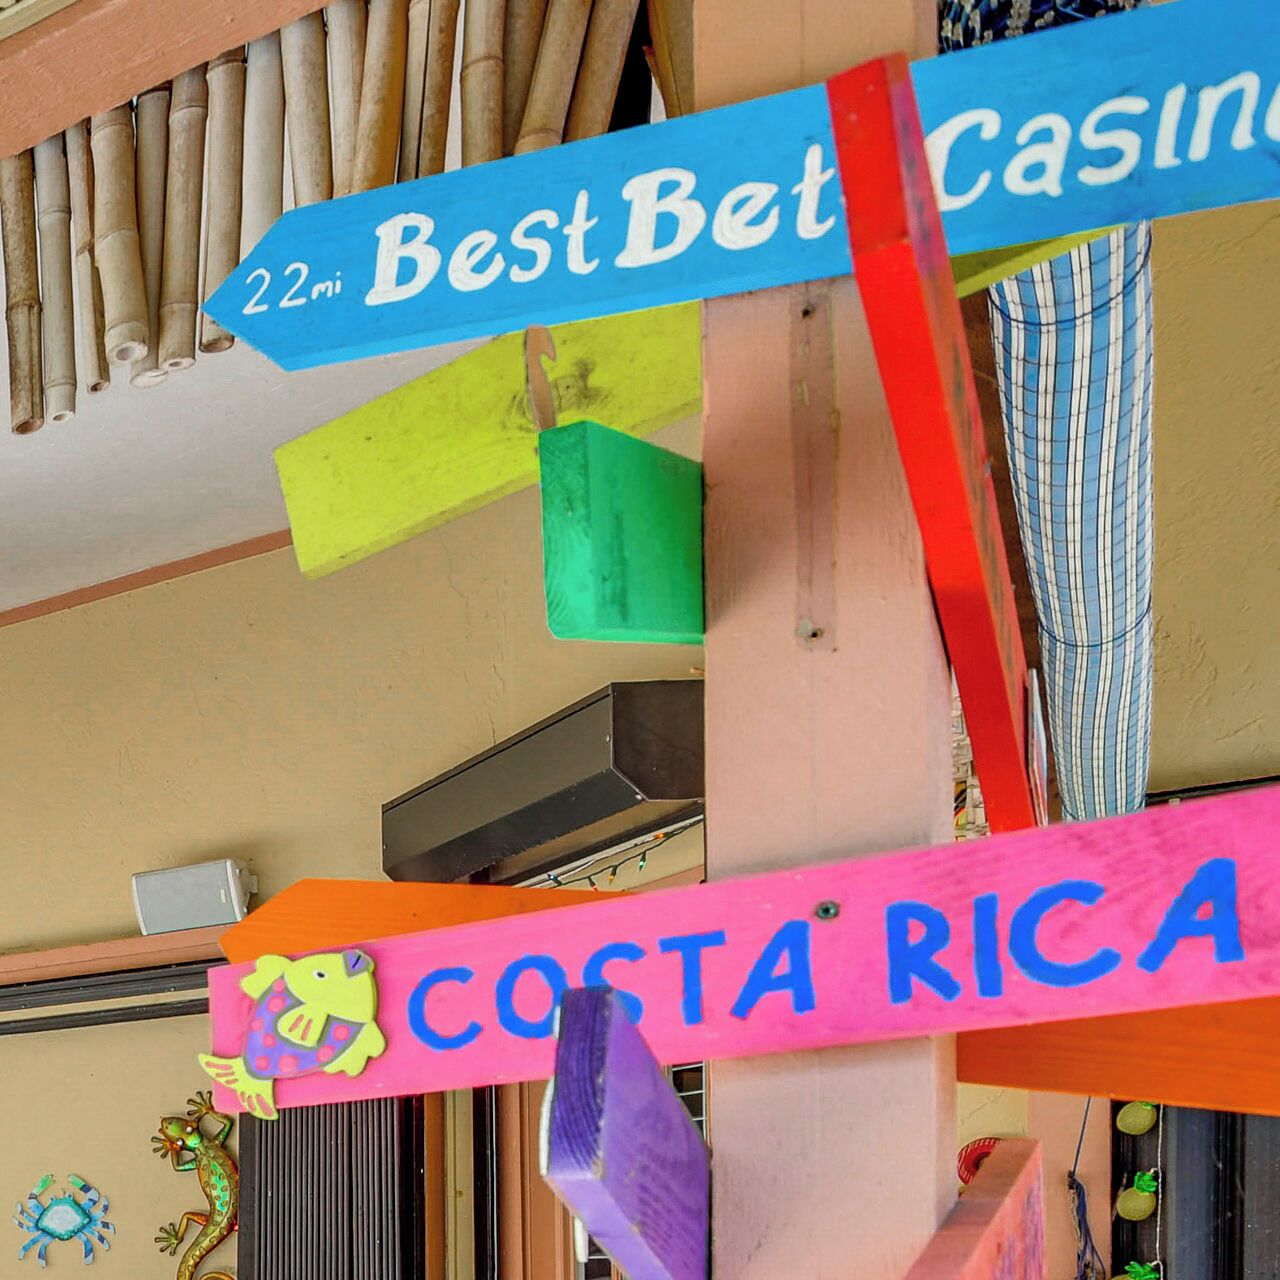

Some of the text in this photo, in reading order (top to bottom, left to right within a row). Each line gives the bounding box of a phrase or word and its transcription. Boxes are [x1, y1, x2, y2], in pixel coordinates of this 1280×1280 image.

[364, 188, 599, 306] Best
[614, 143, 835, 268] Bet
[924, 71, 1280, 212] Casin
[406, 857, 1246, 1051] COSTA RICA
